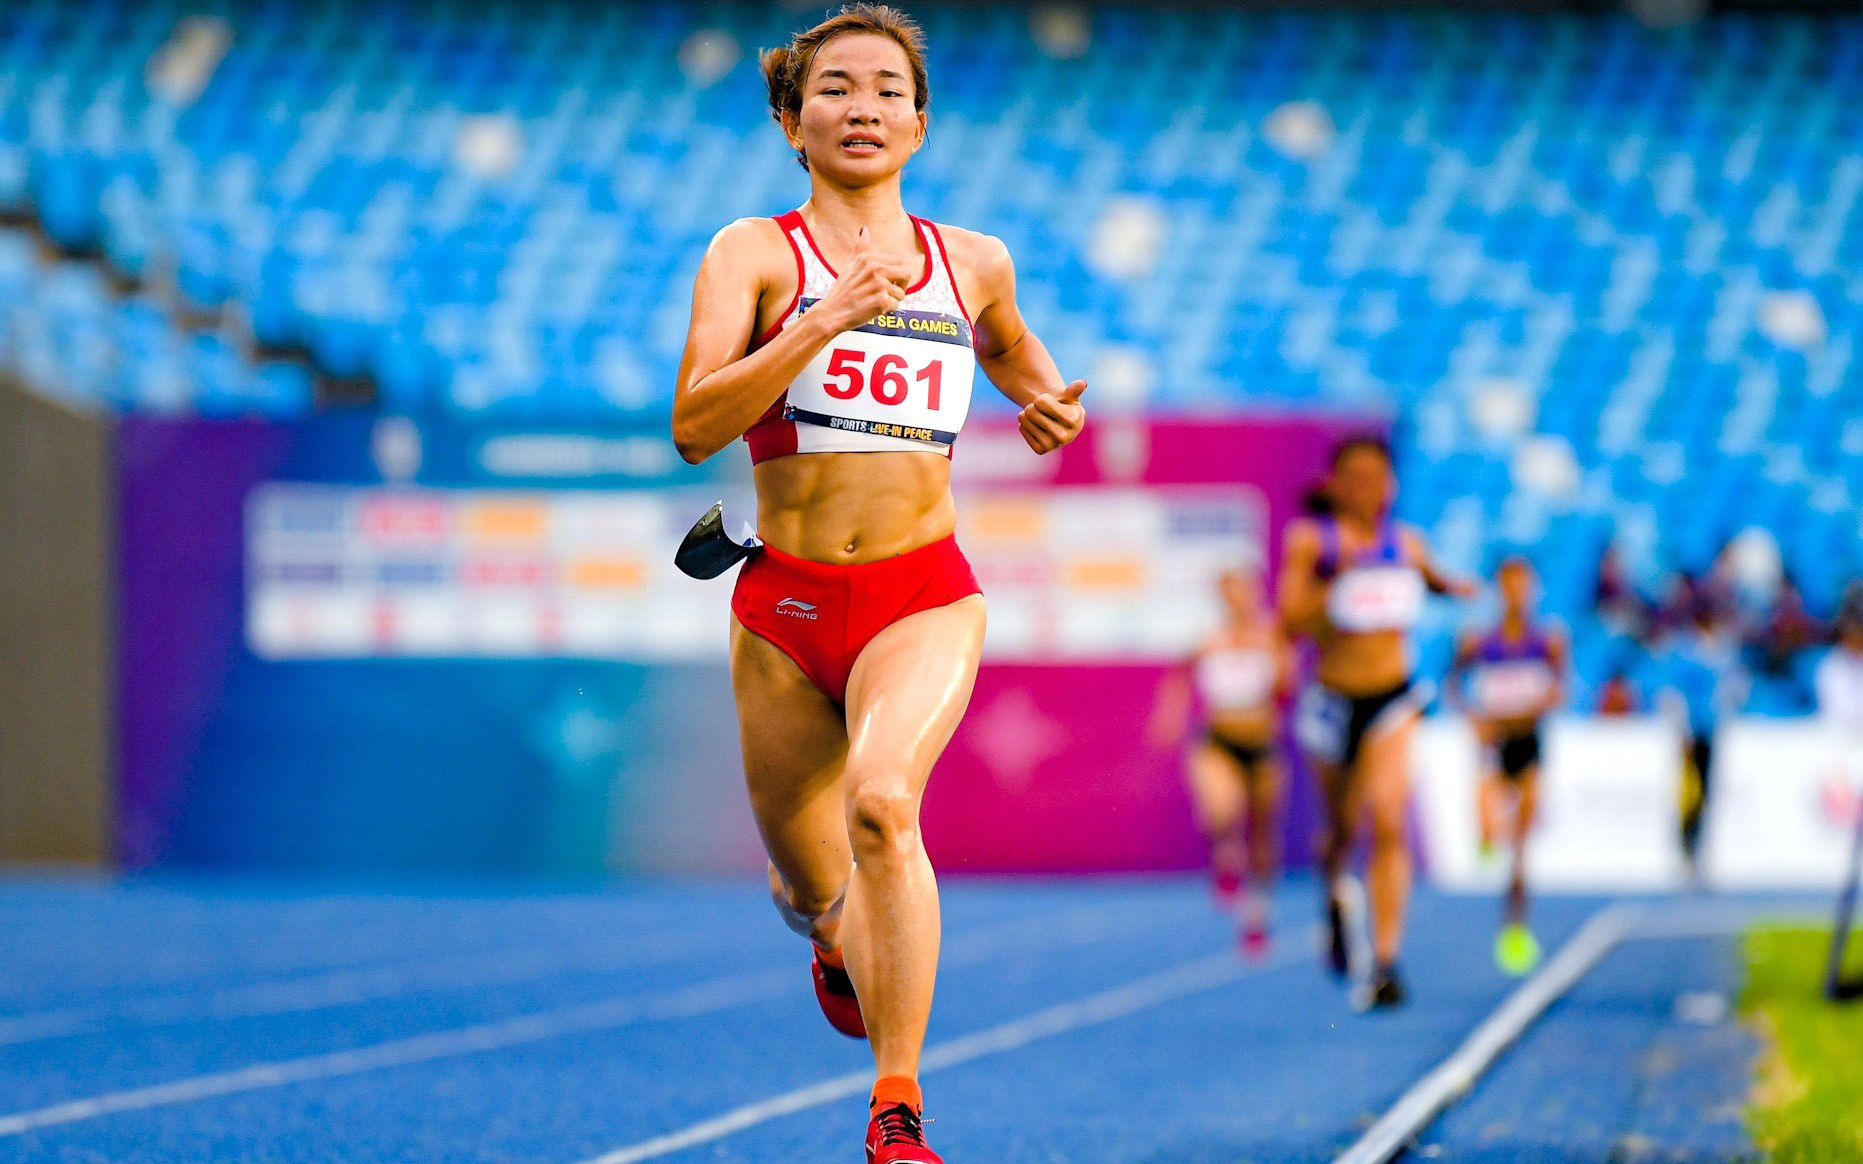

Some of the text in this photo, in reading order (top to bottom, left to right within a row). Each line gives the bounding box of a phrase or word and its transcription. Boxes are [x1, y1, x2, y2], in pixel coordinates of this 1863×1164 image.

[877, 314, 906, 329] SEA
[909, 317, 958, 336] GAMES
[823, 348, 942, 411] 561
[903, 427, 932, 440] PEACE
